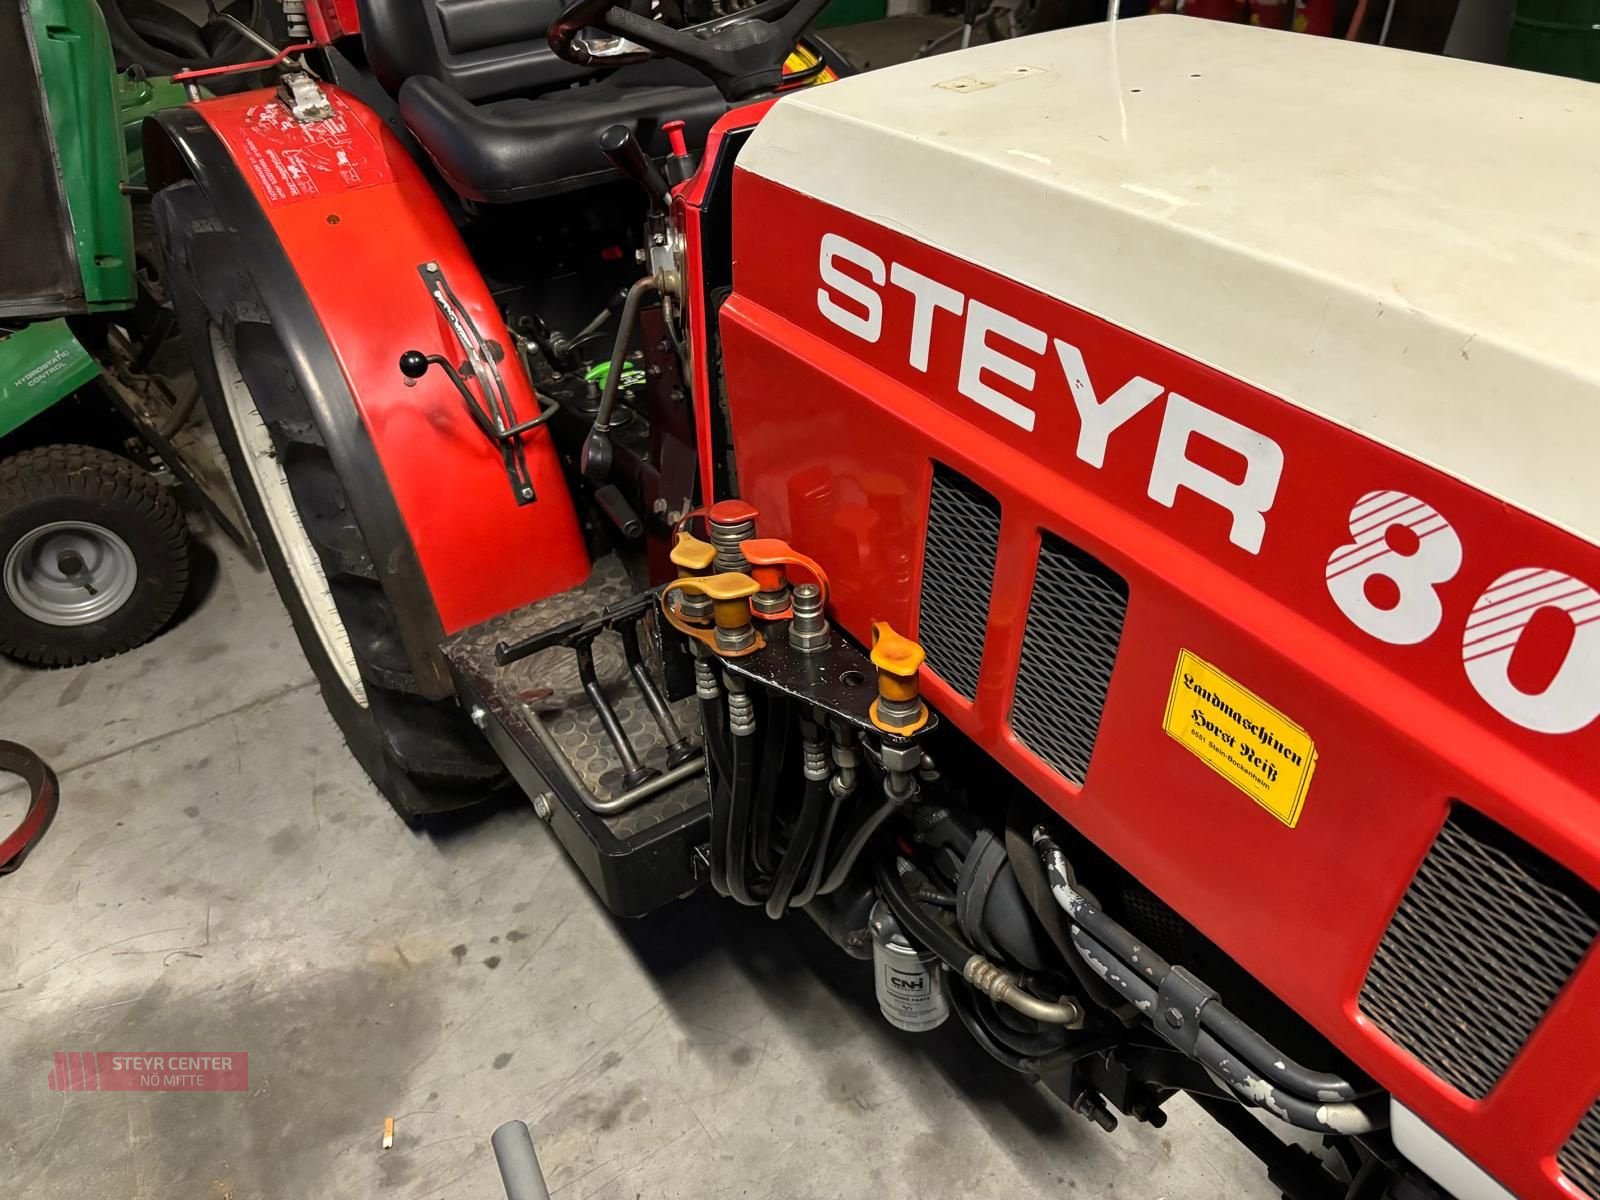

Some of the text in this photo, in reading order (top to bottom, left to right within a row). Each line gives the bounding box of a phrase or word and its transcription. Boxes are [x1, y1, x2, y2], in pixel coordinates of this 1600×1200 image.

[14, 350, 70, 387] HYDROSTATIC
[27, 362, 66, 387] CONTROL
[817, 232, 1285, 556] STEYR
[1183, 673, 1302, 767] Landmaschinen
[1191, 709, 1278, 782] Horst Reiß
[1208, 741, 1270, 790] Stein-Bockenheim
